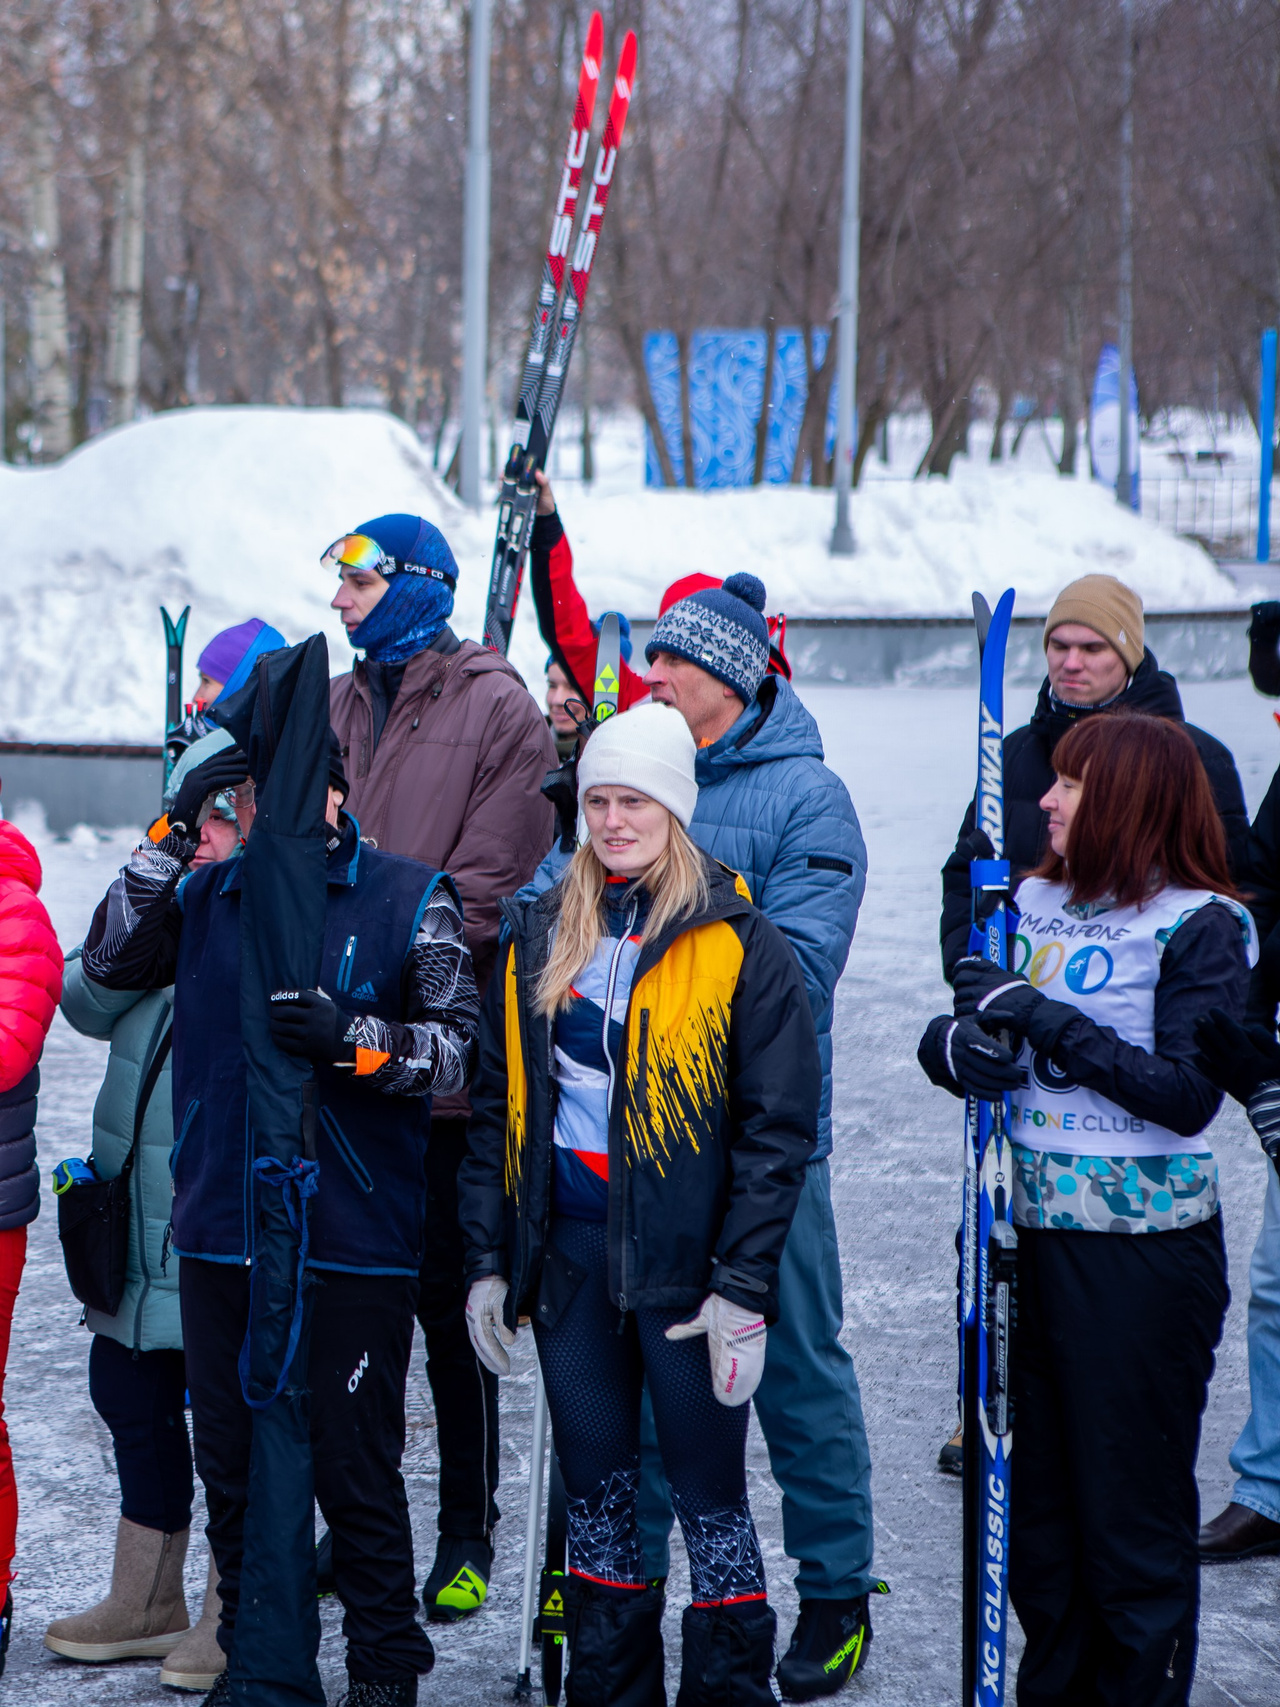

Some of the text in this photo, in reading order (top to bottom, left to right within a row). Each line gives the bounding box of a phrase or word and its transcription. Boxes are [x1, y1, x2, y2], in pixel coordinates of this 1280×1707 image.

[549, 129, 589, 258] STC
[572, 146, 617, 273] STC
[981, 700, 1005, 861] RDWAY
[271, 991, 299, 1001] adidas
[352, 991, 379, 1003] adidas
[981, 1247, 994, 1327] NORDWAY
[983, 1473, 1005, 1697] XC CLASSIC
[823, 1633, 859, 1674] FISCHER
